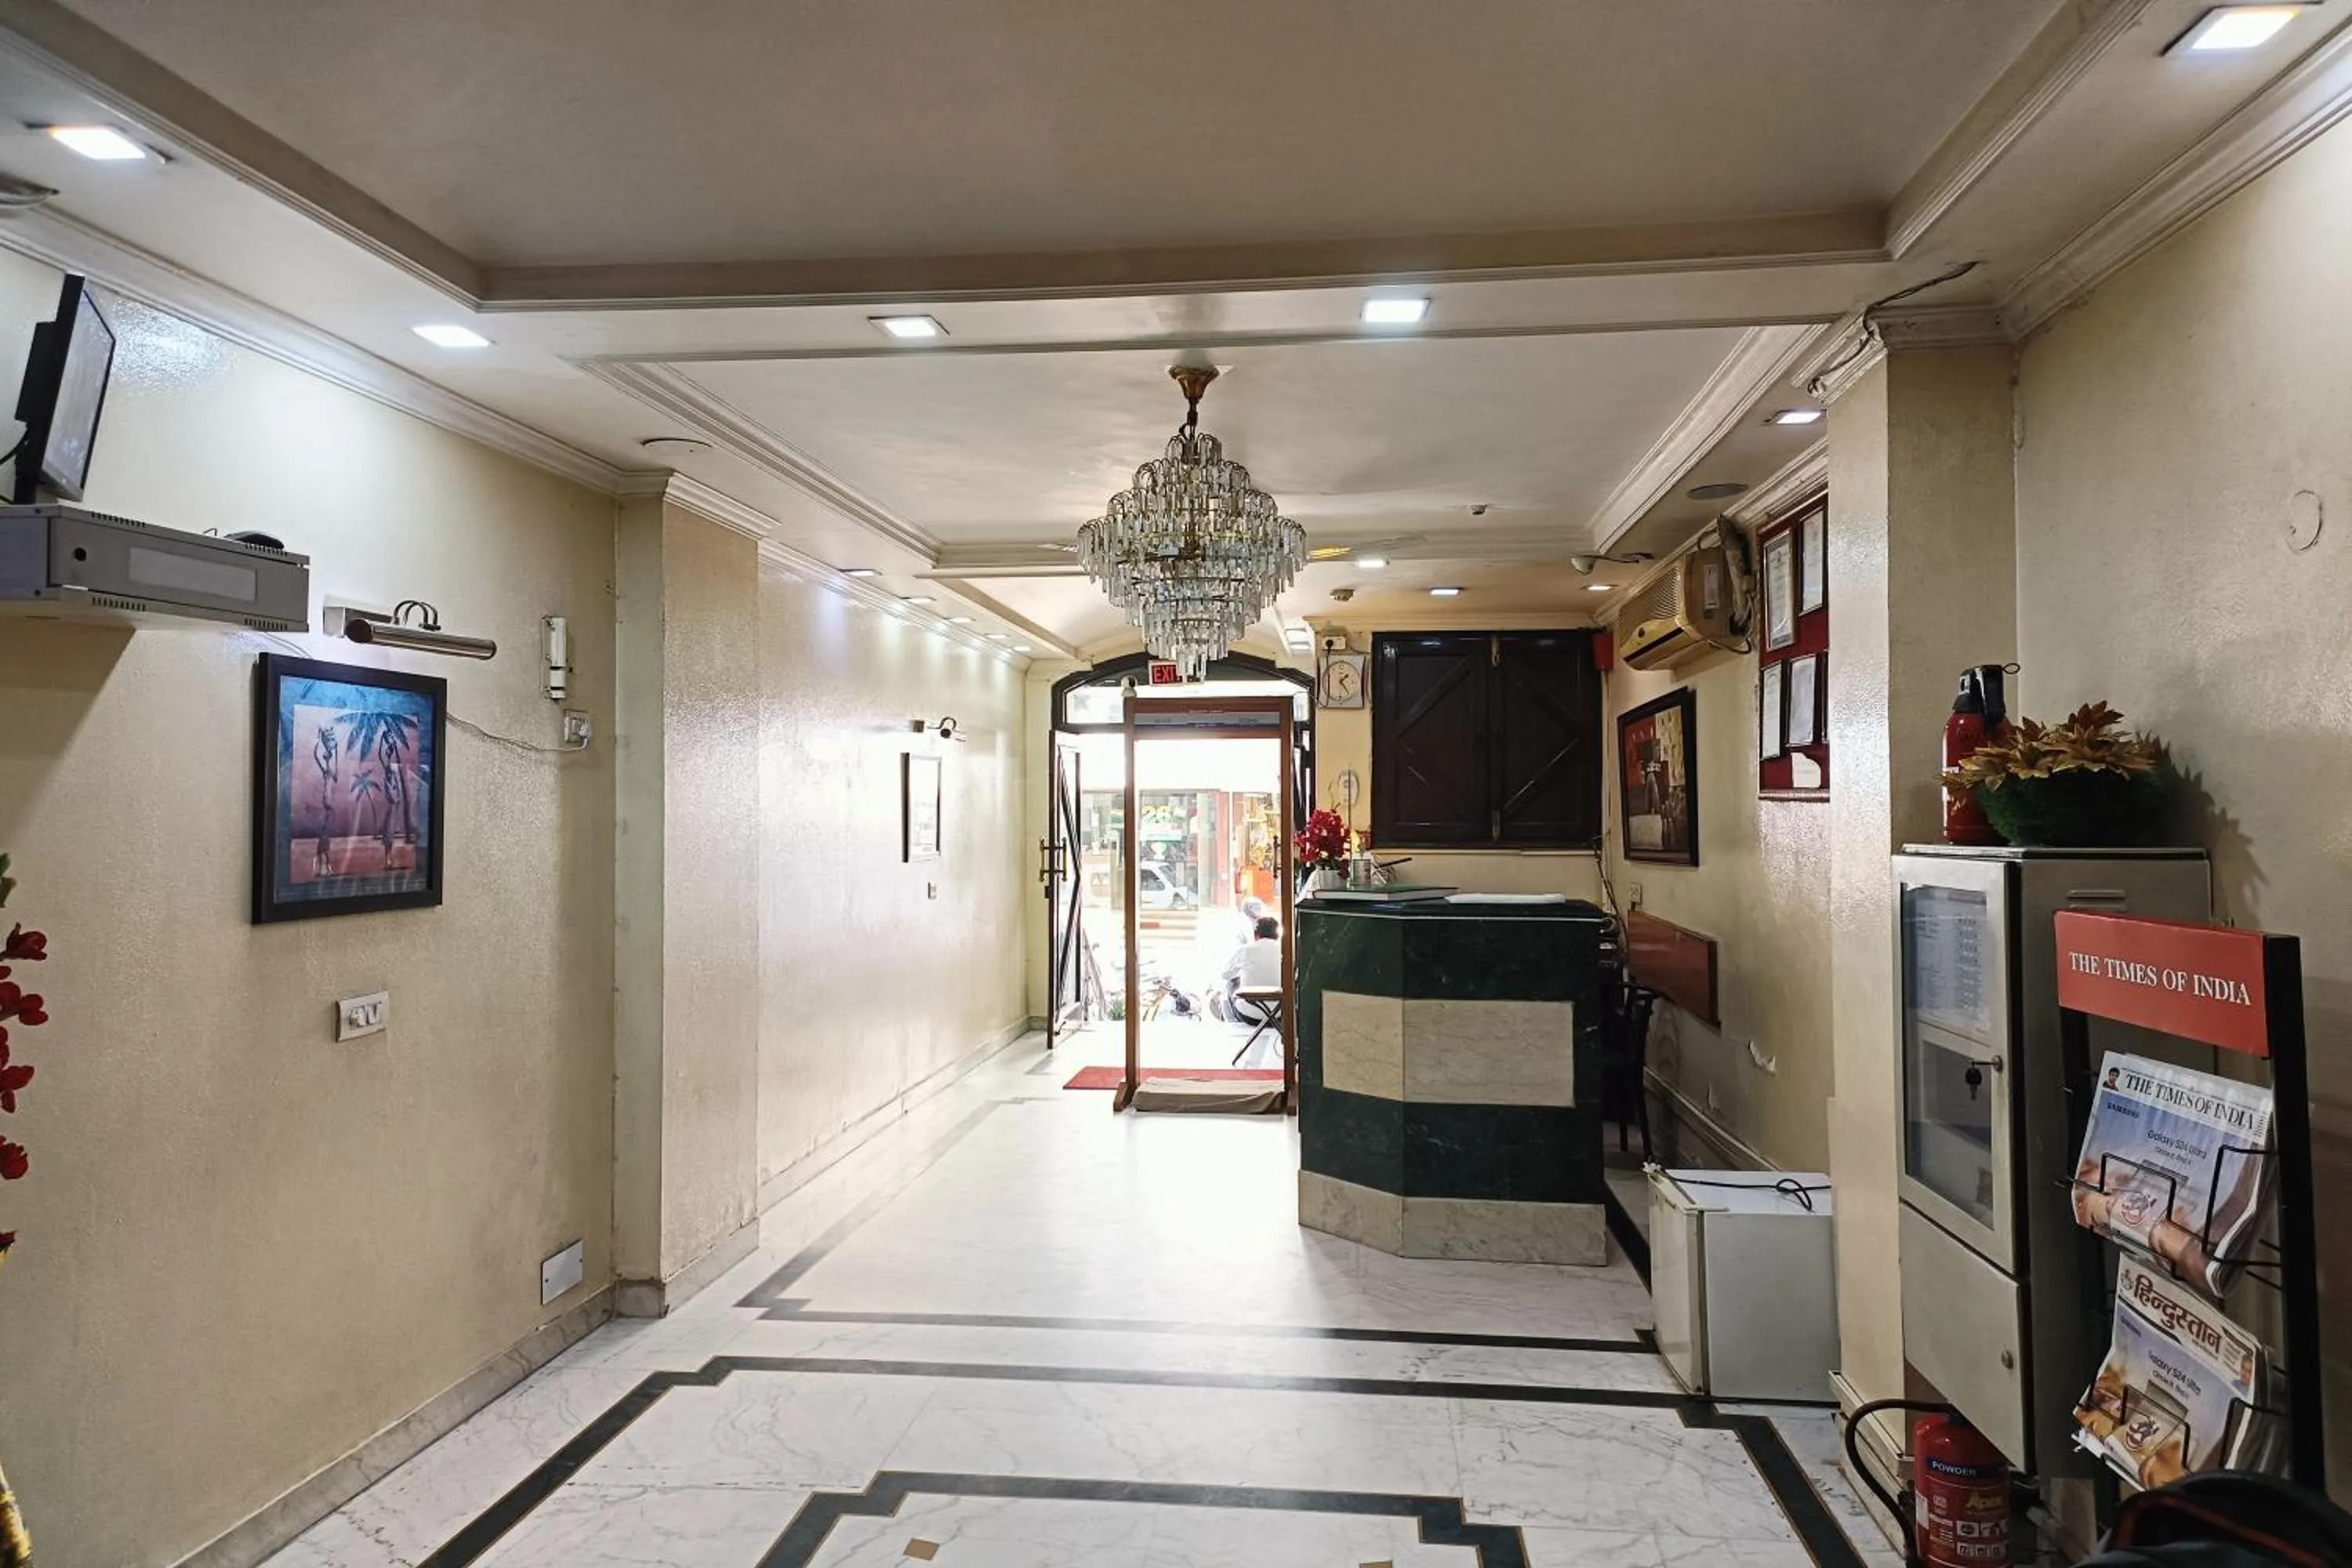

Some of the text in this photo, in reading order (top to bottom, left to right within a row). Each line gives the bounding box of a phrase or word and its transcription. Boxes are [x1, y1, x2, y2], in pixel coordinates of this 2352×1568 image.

[2068, 951, 2252, 1006] THE TIMES OF INDIA
[2125, 1073, 2154, 1095] THE
[2156, 1083, 2194, 1109] TIMES
[2194, 1097, 2212, 1116] OF
[2214, 1102, 2253, 1130] INDIA
[2133, 1273, 2222, 1354] हिन्दुस्तान
[1931, 1460, 1977, 1477] POWDER
